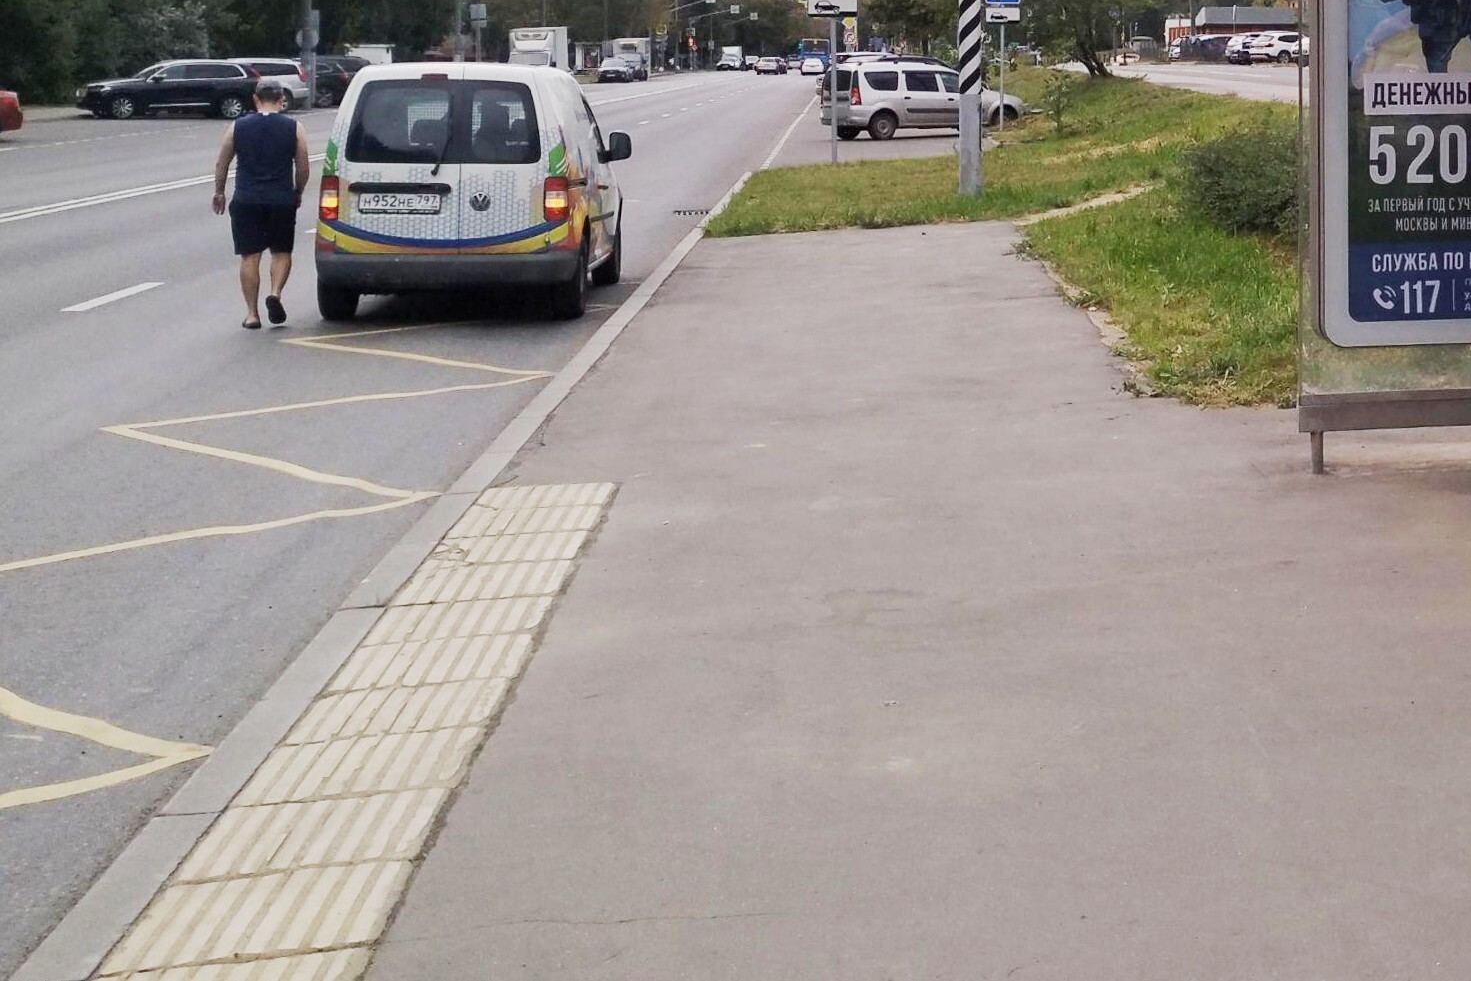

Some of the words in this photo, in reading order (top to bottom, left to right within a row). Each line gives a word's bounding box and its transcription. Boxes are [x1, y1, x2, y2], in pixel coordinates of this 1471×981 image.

[1368, 198, 1381, 213] ЗА
[1383, 196, 1424, 213] ПЕРВЫЙ
[1426, 197, 1446, 213] ГОД
[1449, 197, 1456, 211] С
[1395, 217, 1438, 232] МОСКВЫ
[1441, 217, 1448, 231] И
[1371, 252, 1439, 273] СЛУЖБА
[1443, 252, 1464, 270] ПО
[1400, 280, 1440, 314] 117
